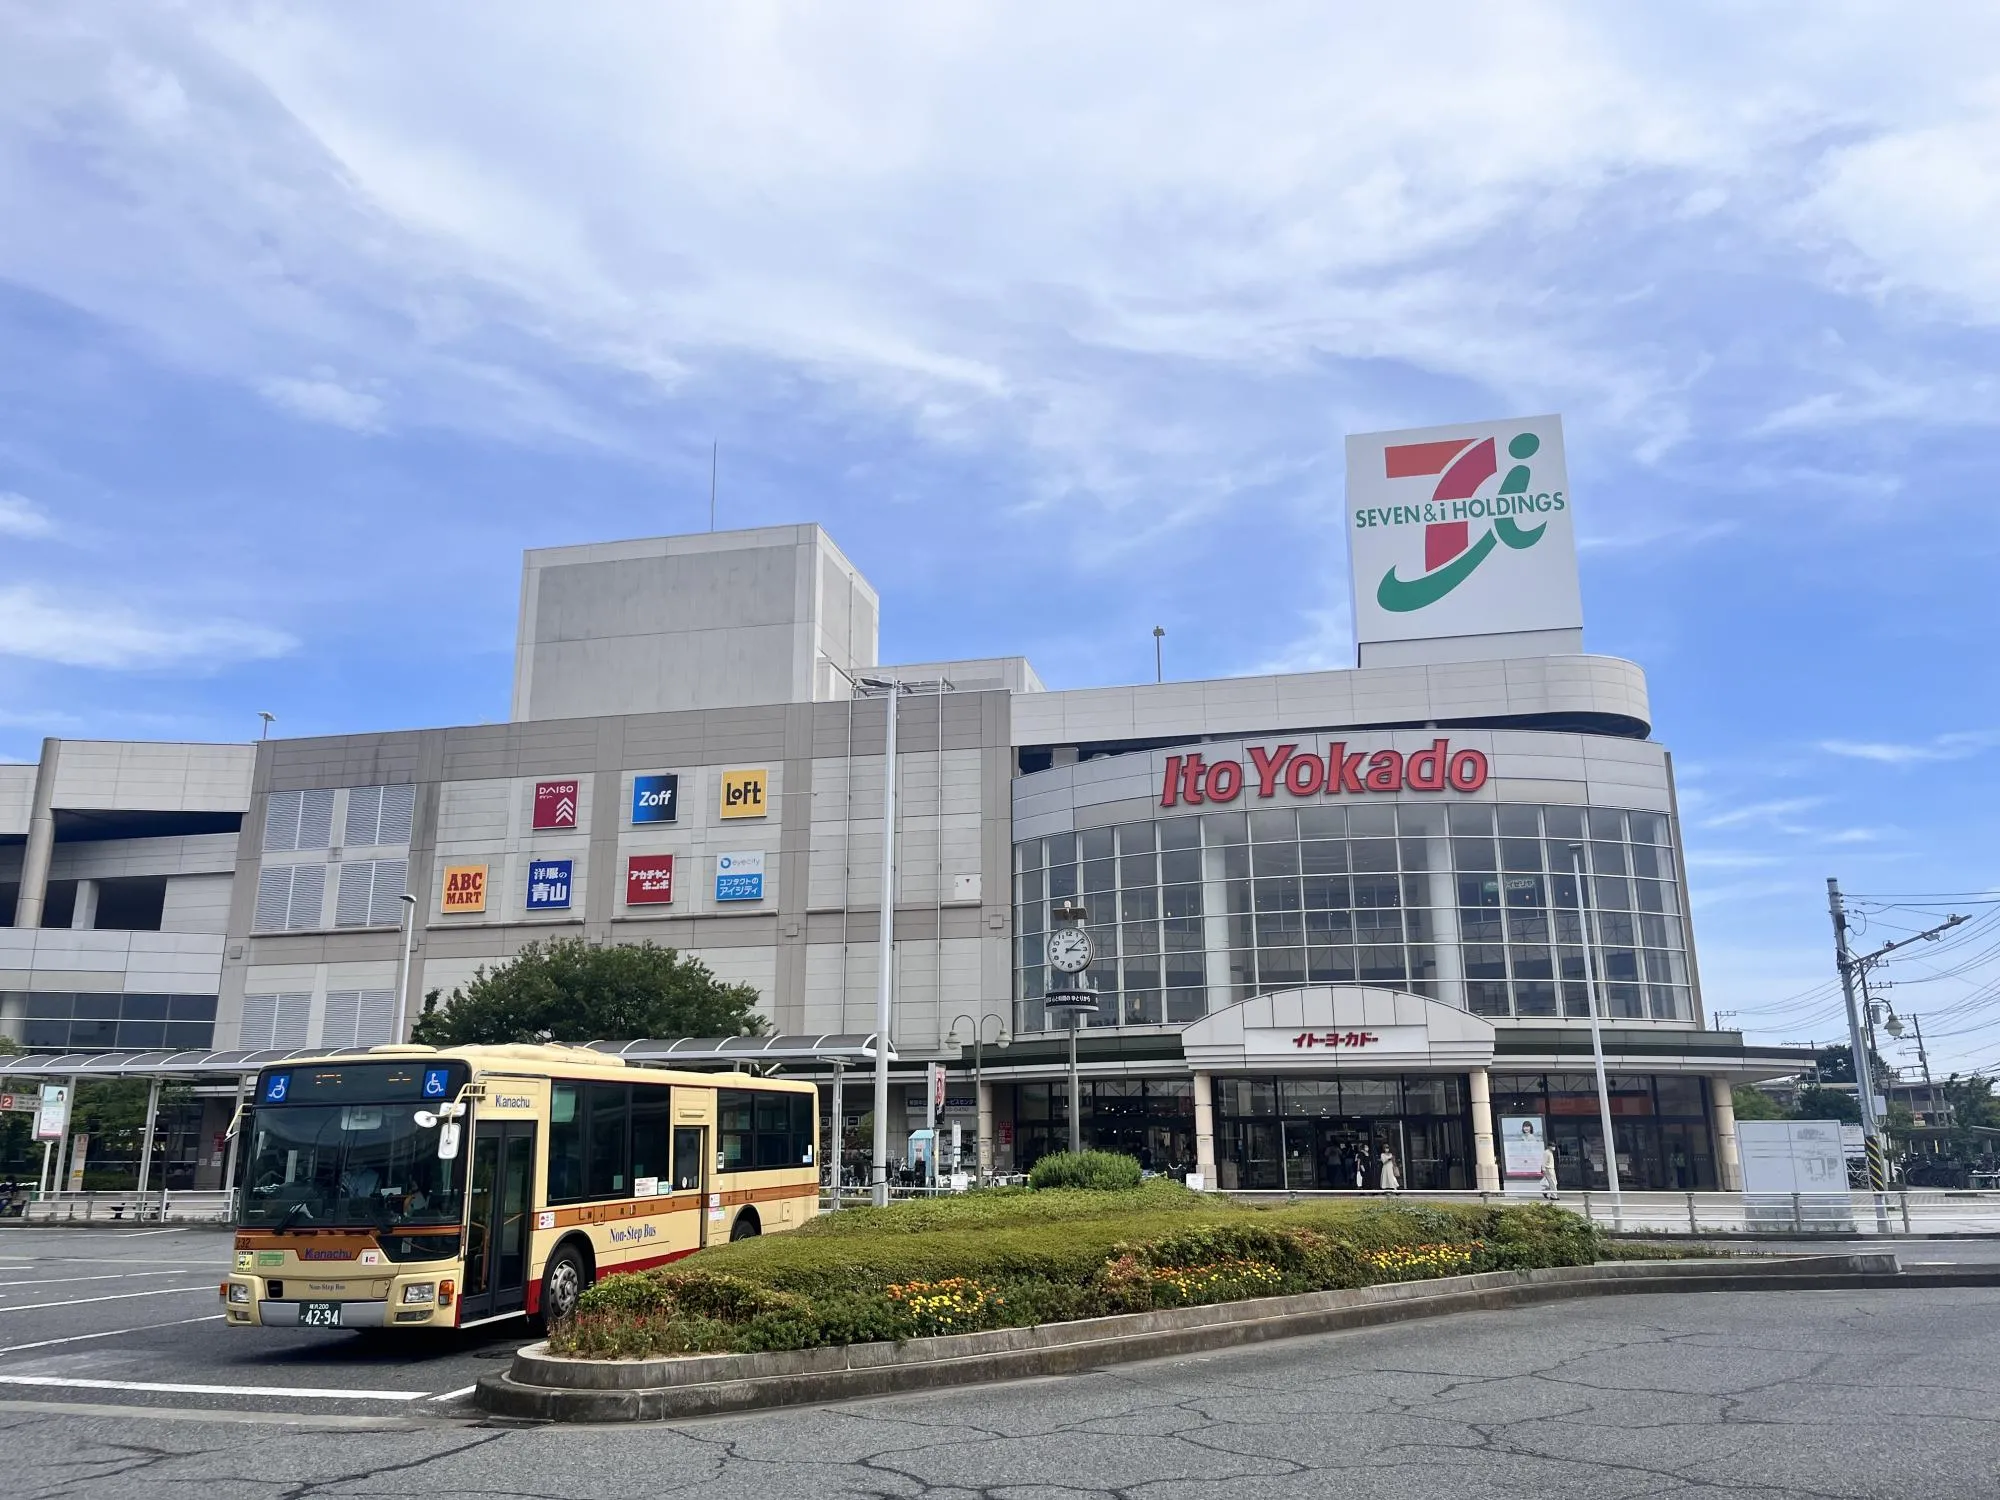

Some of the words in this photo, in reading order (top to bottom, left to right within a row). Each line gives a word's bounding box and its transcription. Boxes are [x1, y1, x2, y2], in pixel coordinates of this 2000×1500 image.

[1453, 491, 1565, 520] HOLDINGS
[539, 785, 574, 795] DAISO
[639, 790, 672, 806] Zoff
[732, 856, 761, 866] eyecity
[533, 867, 568, 880] 洋服の
[630, 869, 670, 881] アカチャン
[447, 872, 482, 892] ABC
[719, 877, 759, 887] コンタクトの
[531, 882, 568, 902] 青山
[719, 885, 758, 896] アイシティ
[446, 892, 482, 905] MART
[1292, 1032, 1379, 1048] イトーヨーカドー
[3, 1097, 12, 1107] 2
[495, 1094, 531, 1108] Kanachu
[610, 1226, 643, 1244] Non-Step
[644, 1223, 657, 1238] Bus
[304, 1248, 353, 1260] Kanachu
